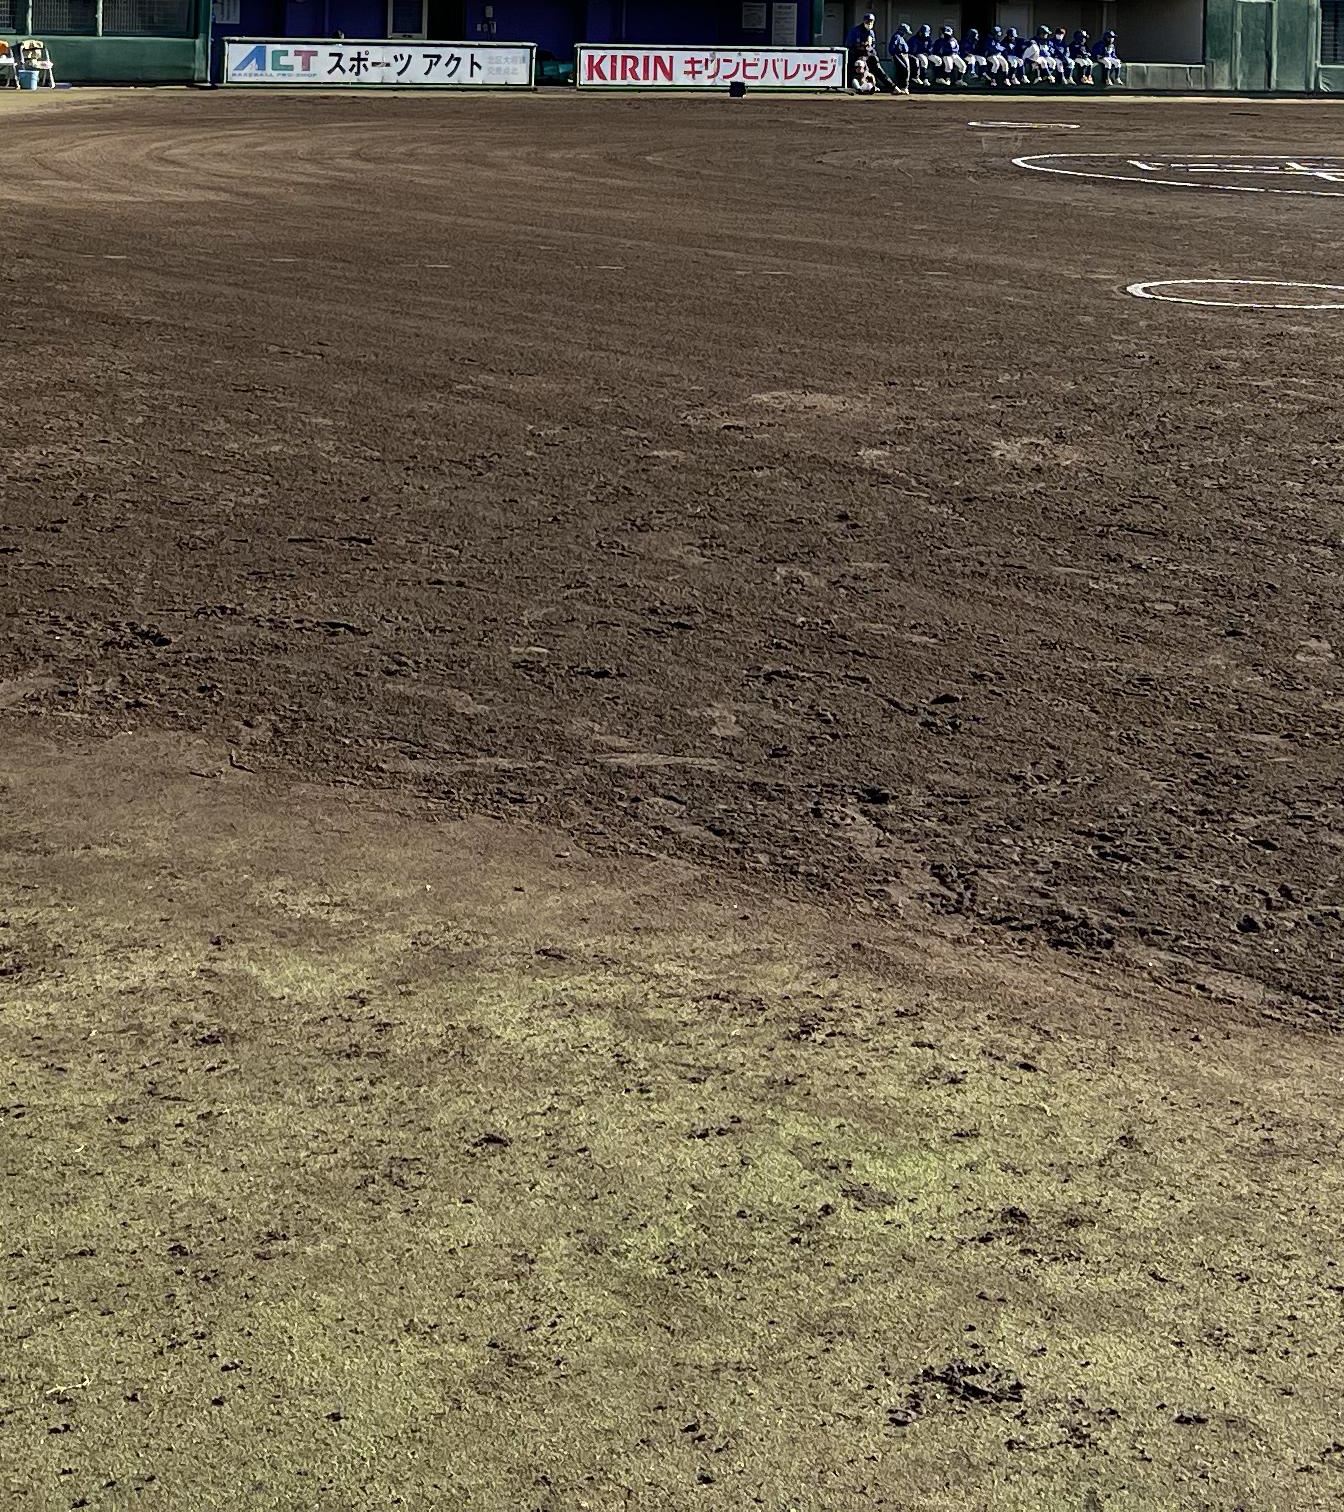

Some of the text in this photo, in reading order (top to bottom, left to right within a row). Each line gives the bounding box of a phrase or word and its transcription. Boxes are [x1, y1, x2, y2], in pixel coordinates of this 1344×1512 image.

[233, 45, 482, 78] ACT スポーツ アクト
[586, 54, 836, 81] KIRIN キリンビバレッジ
